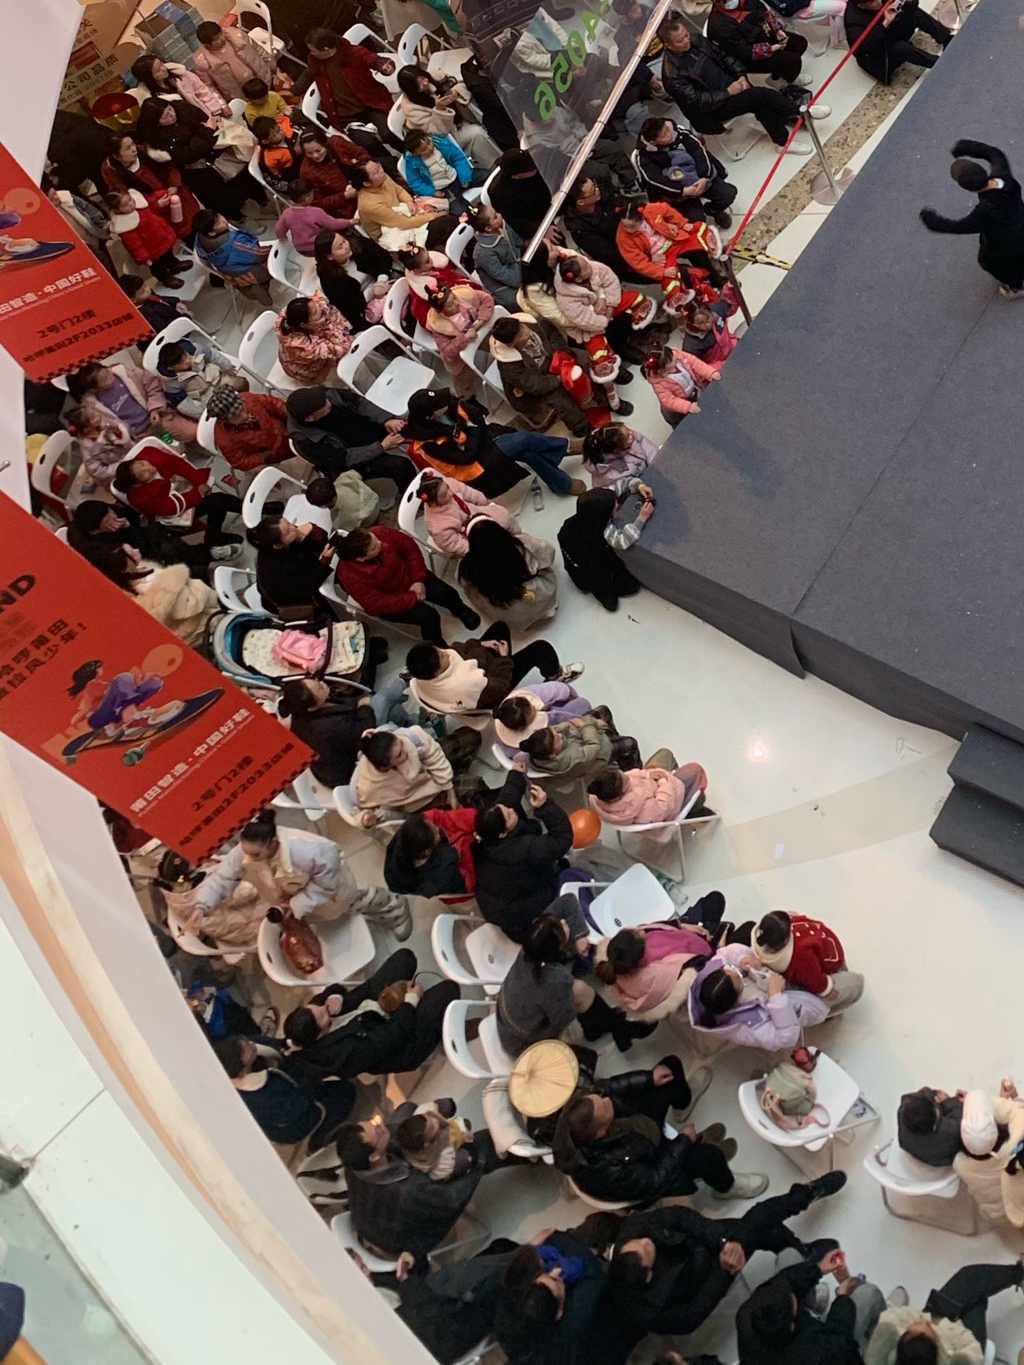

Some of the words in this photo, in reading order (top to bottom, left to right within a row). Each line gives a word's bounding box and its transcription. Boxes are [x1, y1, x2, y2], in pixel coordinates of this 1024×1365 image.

[36, 308, 97, 339] 2号门2楼
[191, 754, 254, 813] 2号门2楼
